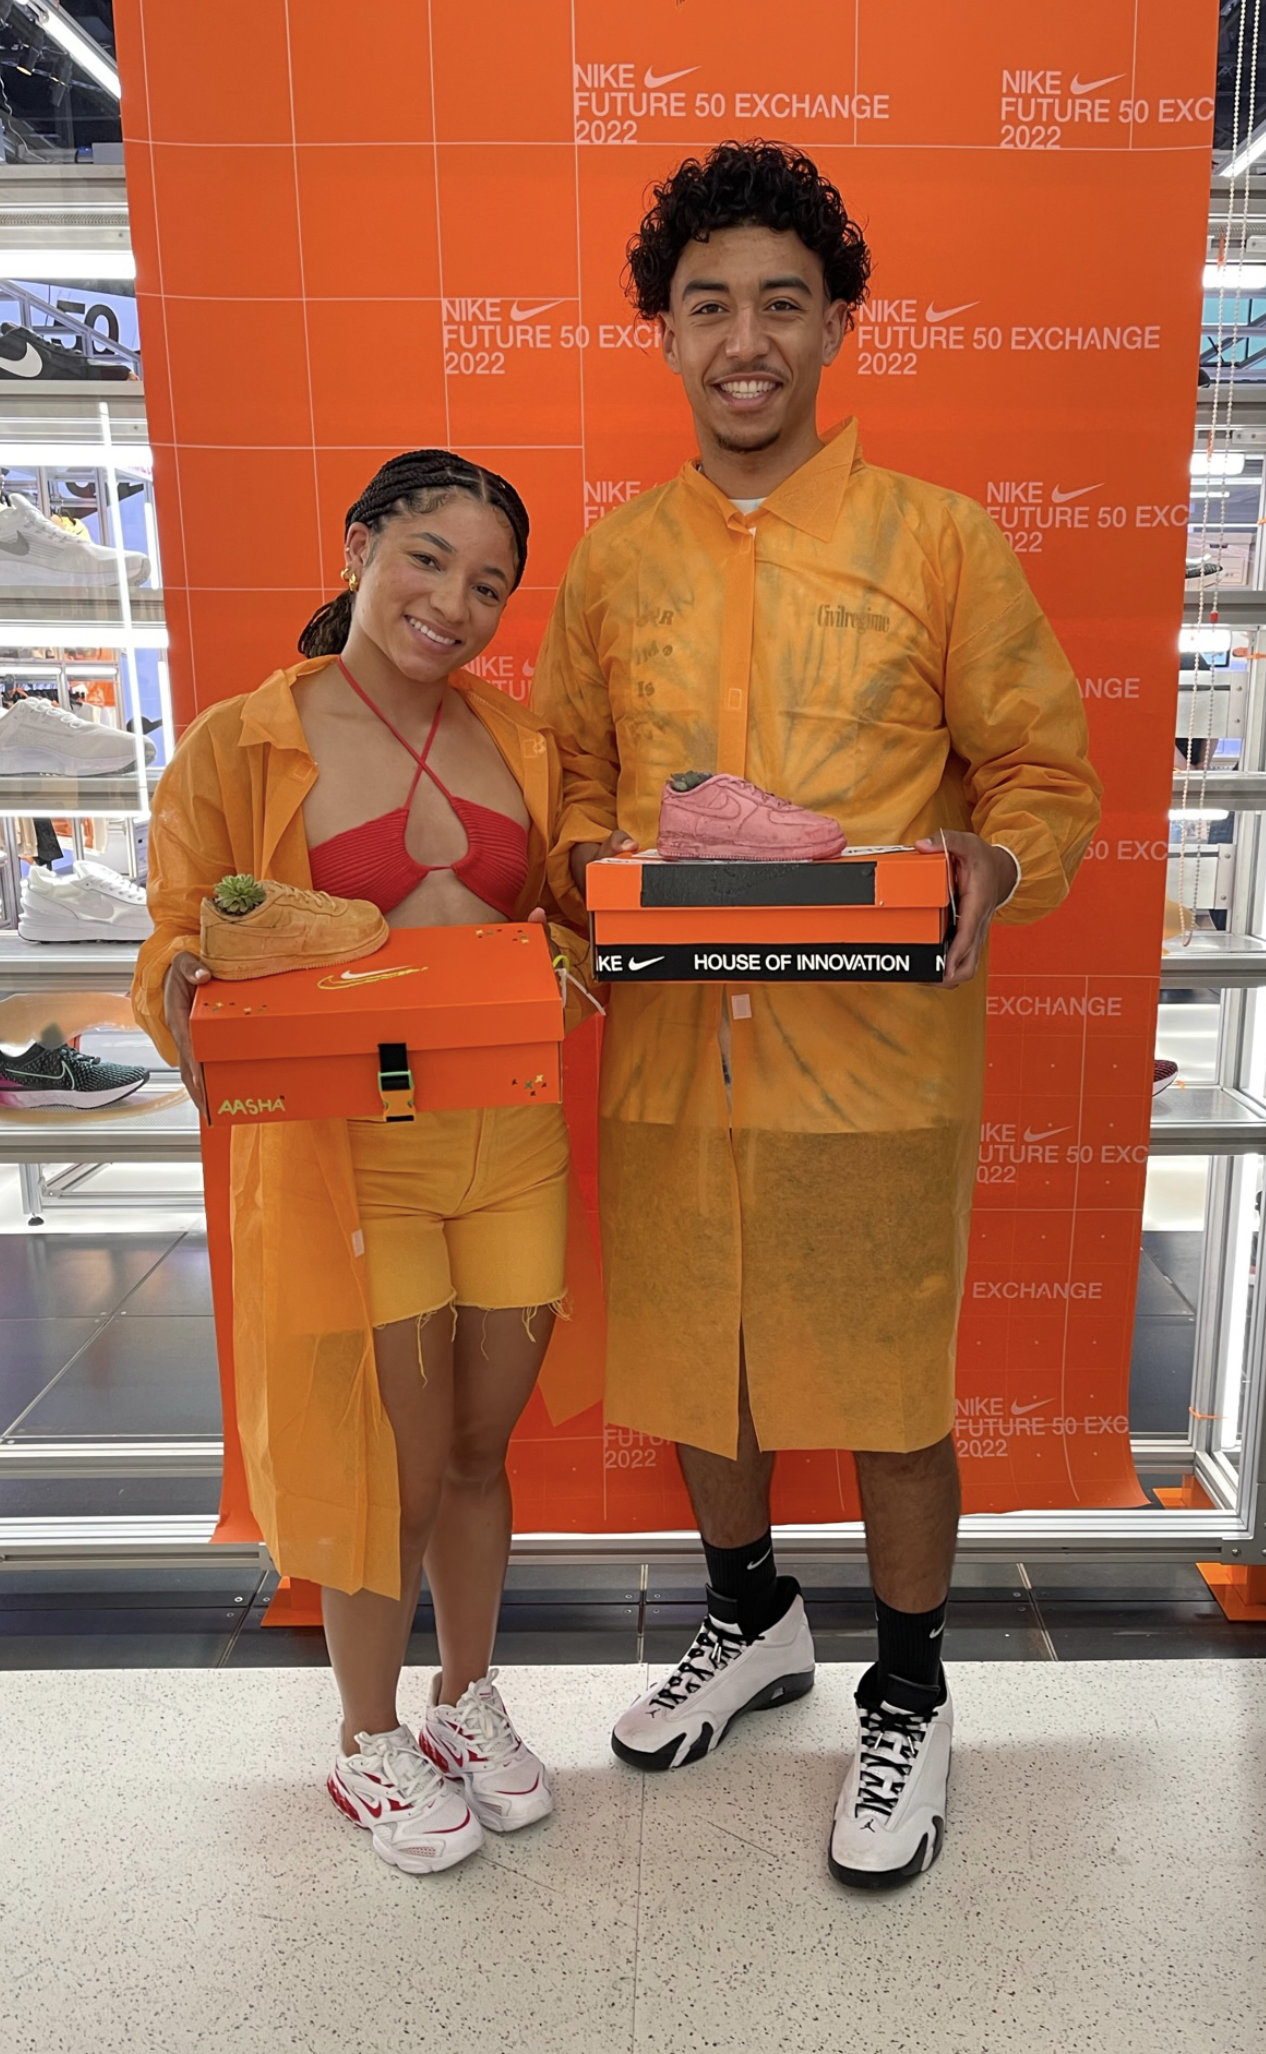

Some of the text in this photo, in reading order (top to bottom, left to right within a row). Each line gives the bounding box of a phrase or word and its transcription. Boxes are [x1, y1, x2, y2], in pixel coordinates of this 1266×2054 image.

[575, 63, 635, 89] NIKE
[1001, 70, 1062, 95] NIKE
[575, 92, 889, 119] FUTURE 50 EXCHANGE
[1001, 97, 1110, 123] FUTURE
[1118, 99, 1149, 124] 50
[574, 120, 638, 144] 2022
[1000, 125, 1061, 149] 2022
[442, 299, 502, 322] NIKE
[858, 299, 917, 323] NIKE
[444, 325, 551, 349] FUTURE
[560, 325, 590, 349] 50
[858, 325, 1161, 351] FUTURE 50 EXCHANGE
[445, 351, 505, 375] 2022
[857, 352, 918, 376] 2022
[986, 481, 1043, 504] NIKE
[986, 506, 1090, 529] FUTURE
[1097, 506, 1127, 529] 50
[694, 953, 761, 971] HOUSE
[765, 953, 792, 971] OF
[796, 953, 910, 972] INNOVATION
[986, 996, 1123, 1016] EXCHANGE
[217, 1097, 286, 1116] AASHA
[980, 1123, 1016, 1142] IKE
[978, 1144, 1059, 1163] UTURE
[1066, 1145, 1093, 1164] 50
[972, 1281, 1103, 1300] EXCHANGE
[954, 1397, 1004, 1417] NIKE
[955, 1417, 1046, 1438] FUTURE
[1052, 1416, 1077, 1436] 50
[604, 1448, 657, 1469] 2022
[956, 1439, 1008, 1458] 2022
